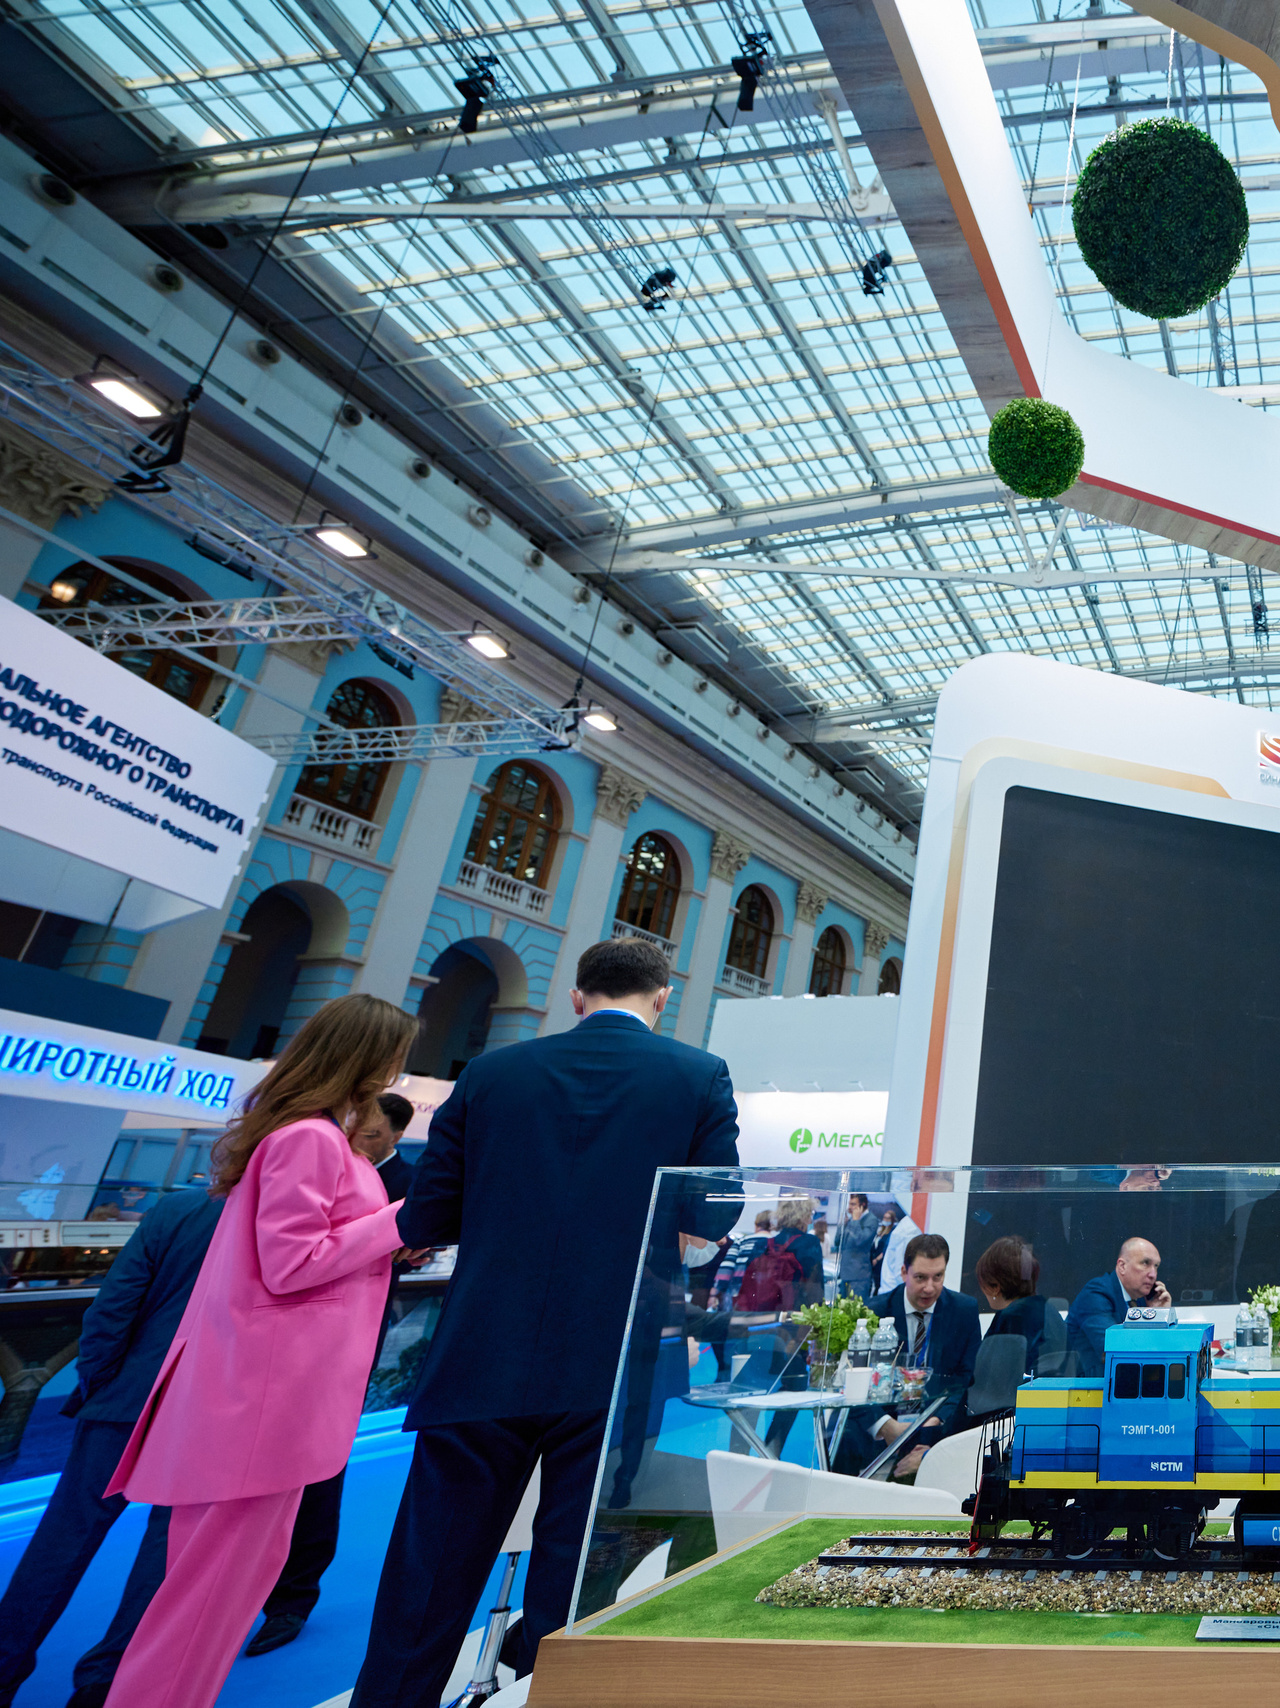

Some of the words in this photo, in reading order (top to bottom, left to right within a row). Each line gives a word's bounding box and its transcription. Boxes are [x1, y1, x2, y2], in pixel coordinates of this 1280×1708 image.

[0, 662, 89, 725] АЛЬНОЕ
[86, 715, 192, 779] АГЕНТСТВО
[0, 696, 144, 783] ОДОРОЖНОГО
[145, 771, 245, 835] ТРАНСПОРТА
[2, 747, 84, 793] транспорта
[85, 780, 159, 826] Российской
[178, 1068, 235, 1108] ХОД
[1121, 1424, 1175, 1435] ТЭМГ1-001
